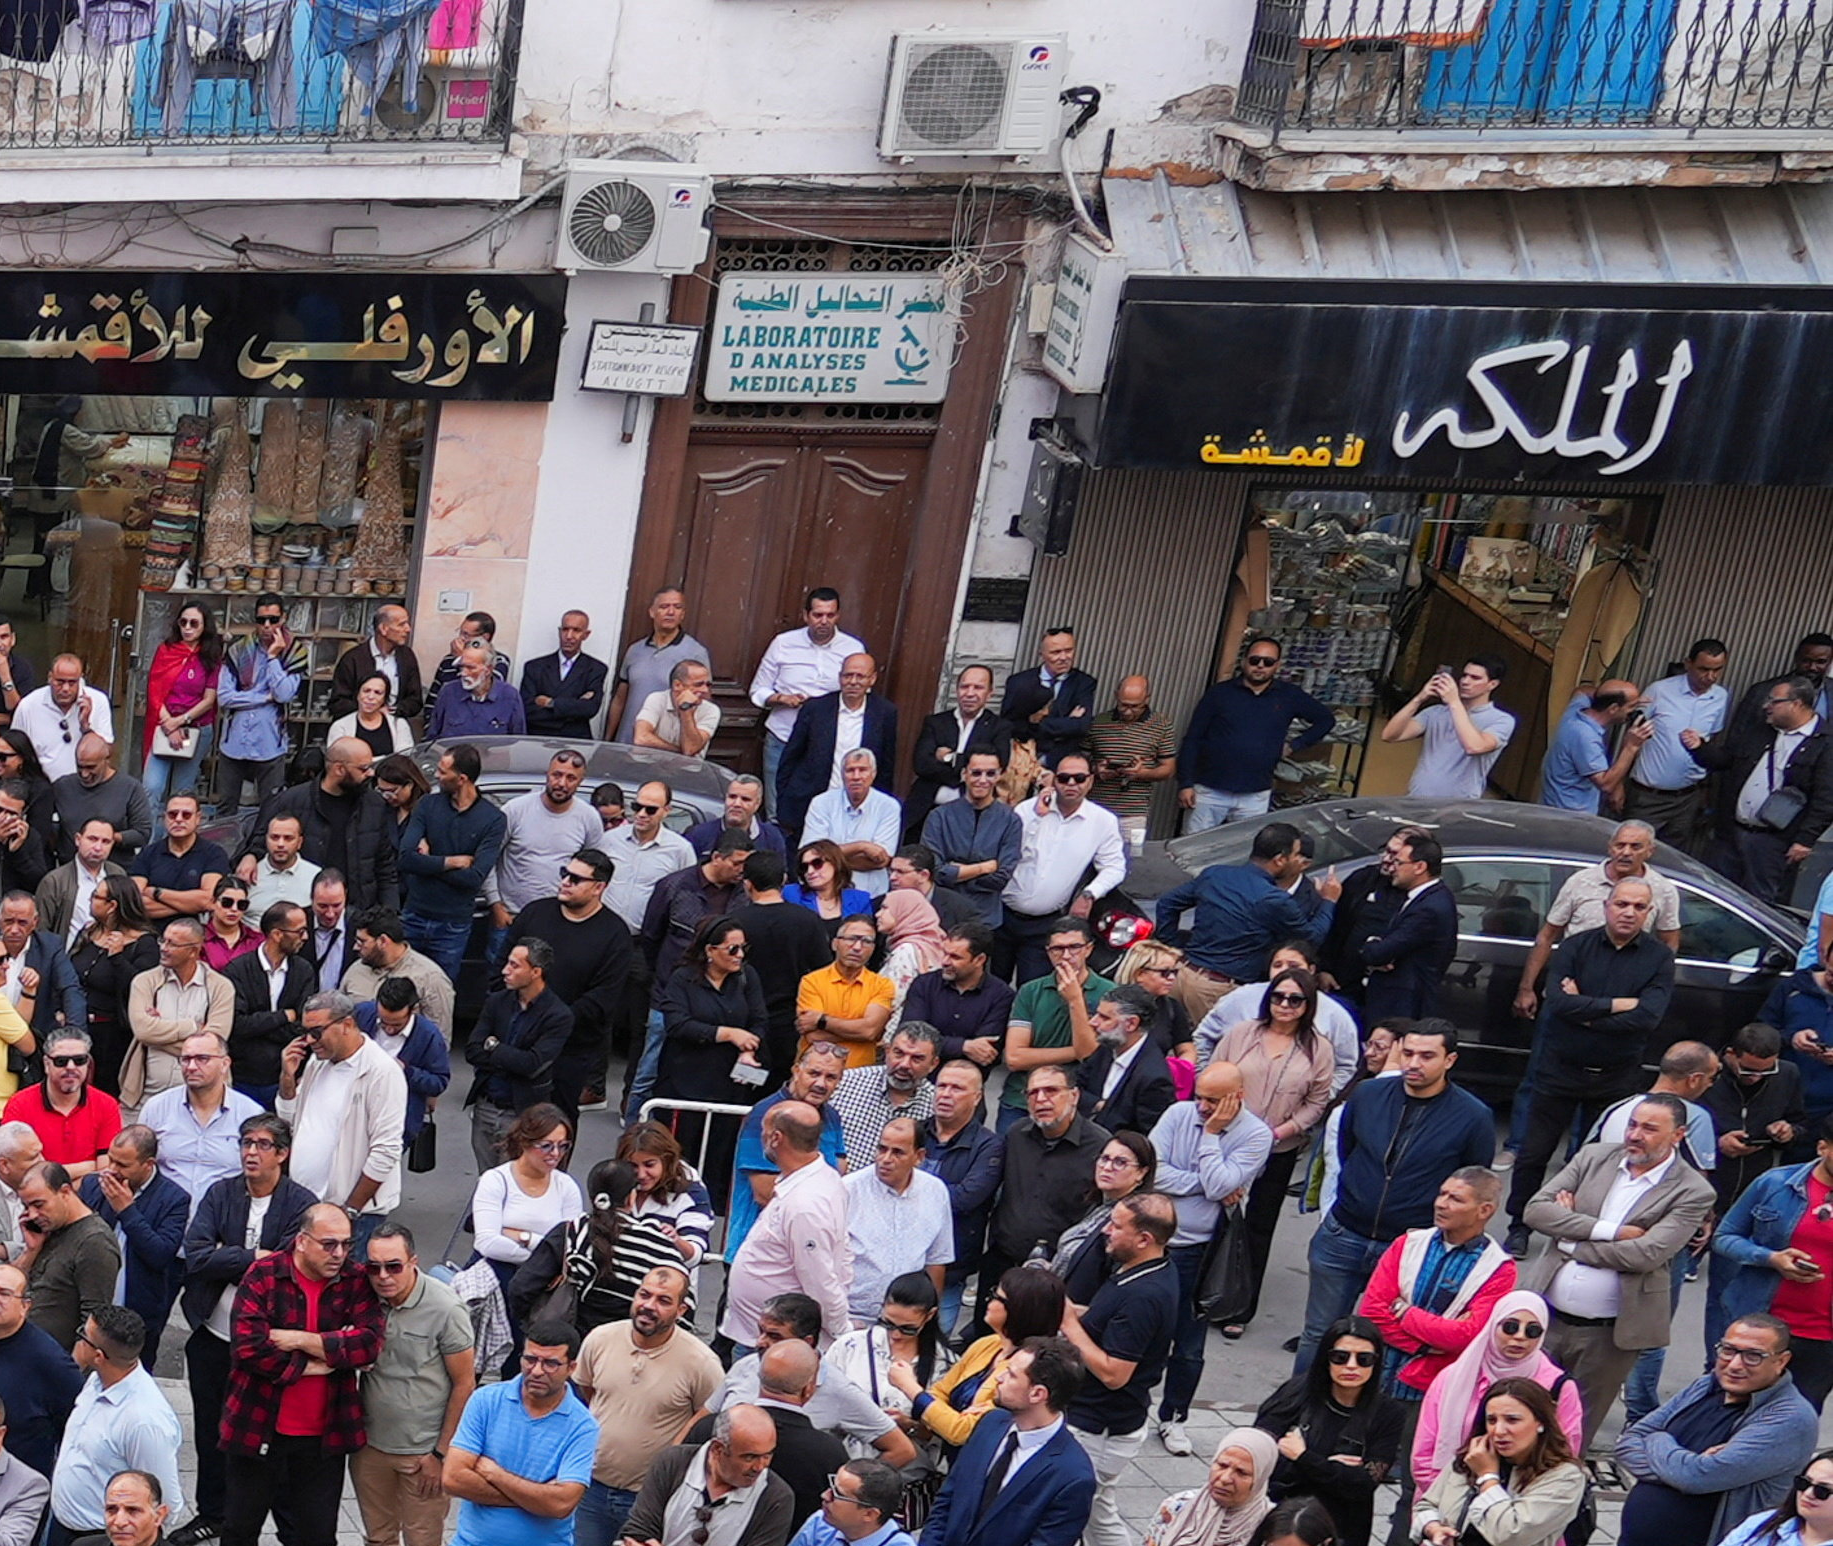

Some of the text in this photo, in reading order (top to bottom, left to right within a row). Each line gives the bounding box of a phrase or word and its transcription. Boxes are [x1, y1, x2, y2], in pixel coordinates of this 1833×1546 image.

[733, 281, 801, 320] الطبية
[805, 280, 894, 319] التحاليل
[722, 325, 882, 349] LABORATOIRE
[751, 353, 866, 370] ANALYSES
[729, 376, 857, 393] MEDICALES
